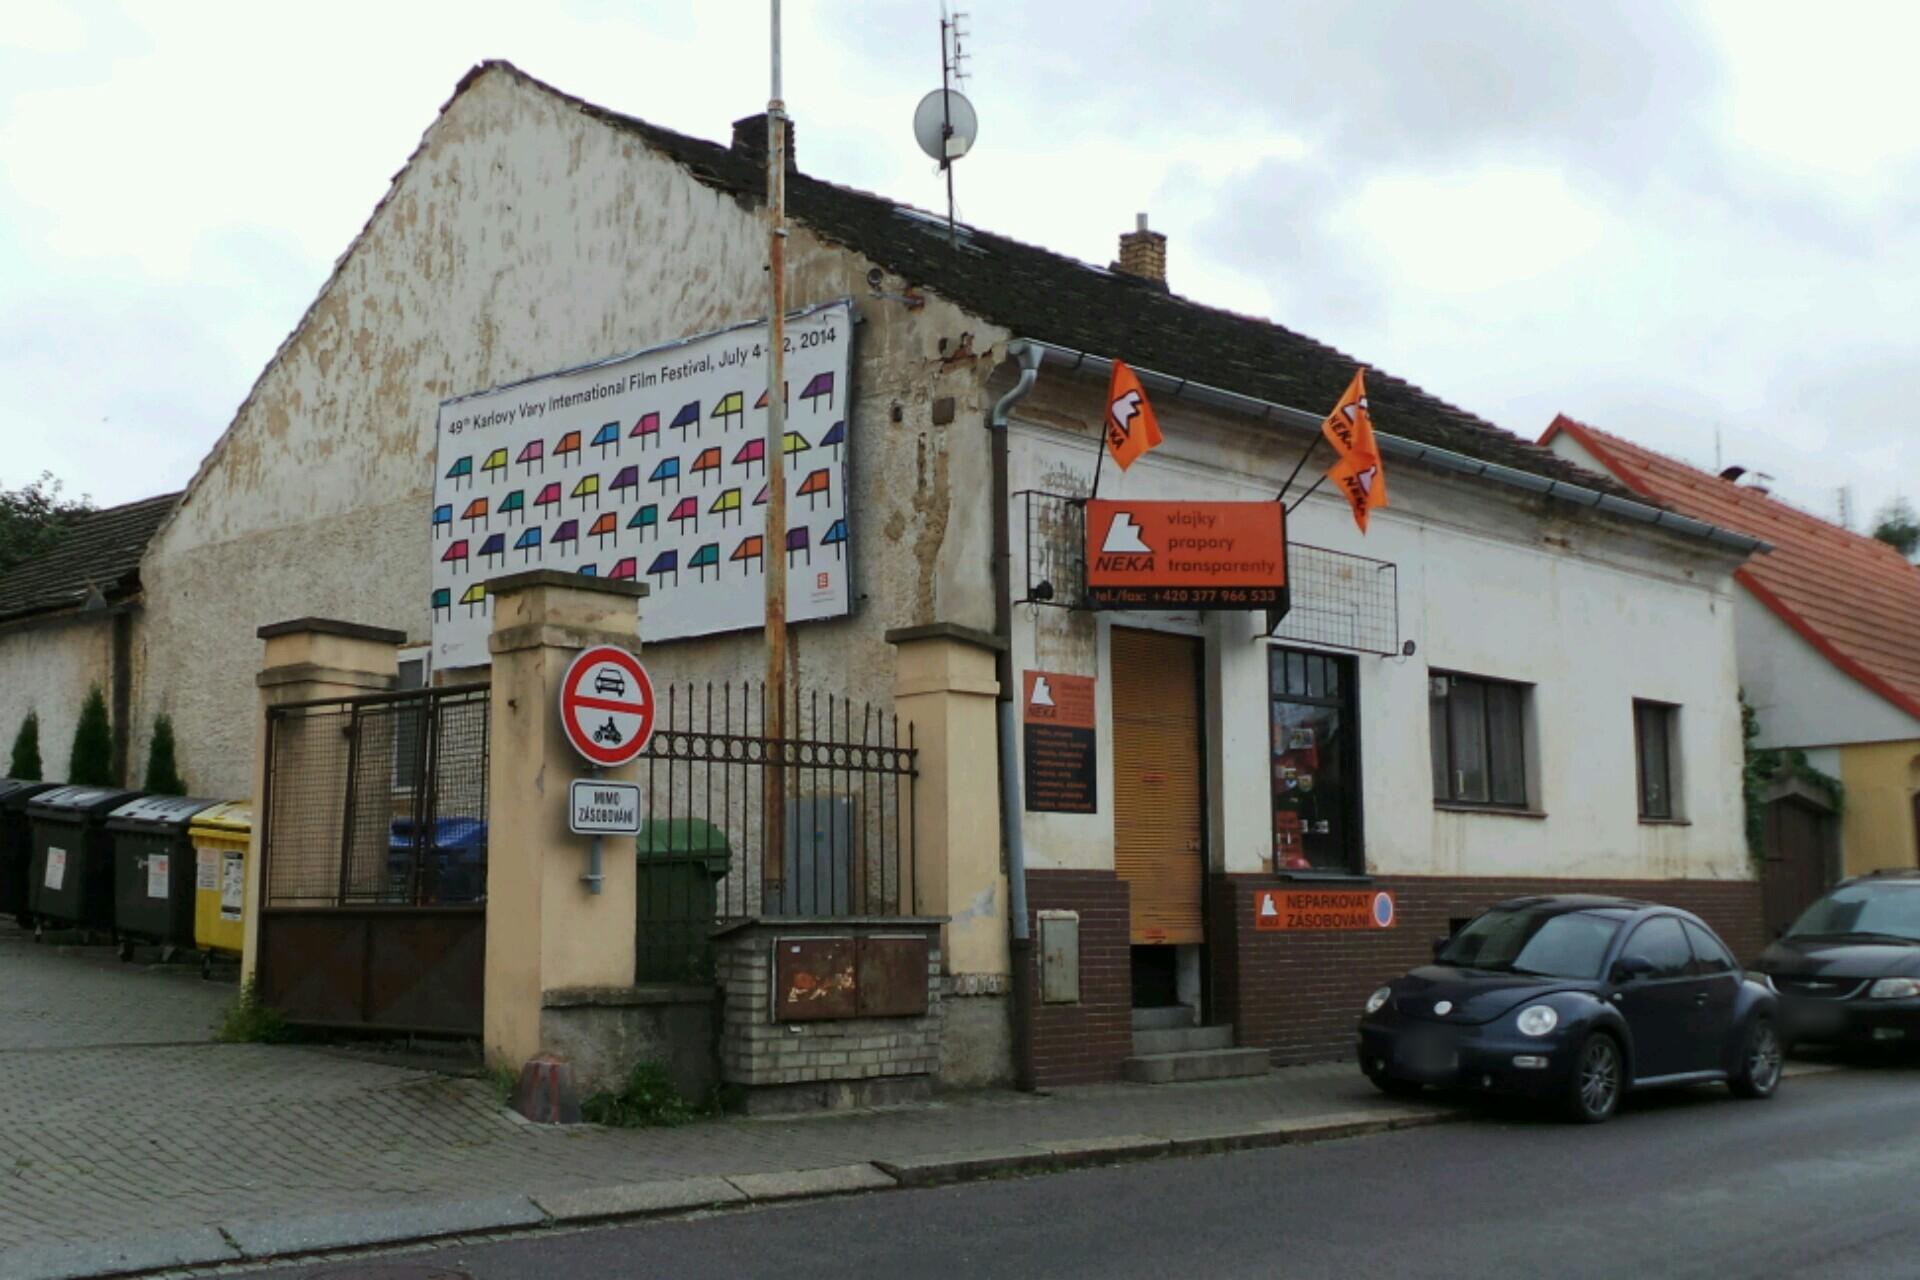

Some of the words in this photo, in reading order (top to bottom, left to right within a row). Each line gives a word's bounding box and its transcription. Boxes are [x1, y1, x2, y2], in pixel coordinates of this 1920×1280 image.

[448, 418, 471, 435] 49th
[473, 409, 516, 430] Karlovy
[519, 401, 546, 418] Vary
[549, 377, 625, 411] International
[629, 371, 657, 391] Film
[660, 355, 714, 384] Festival,
[719, 347, 748, 368] July
[752, 344, 761, 359] 4
[800, 327, 836, 349] 2014
[1167, 511, 1216, 529] vlajky
[1167, 537, 1235, 552] prapory
[1095, 556, 1155, 572] NEKA
[1168, 559, 1276, 576] transparenty
[1153, 589, 1188, 602] +420
[1191, 589, 1217, 602] 377
[1220, 589, 1247, 602] 966
[1250, 589, 1276, 602] 533
[1287, 894, 1370, 909] NEPARKOVAT
